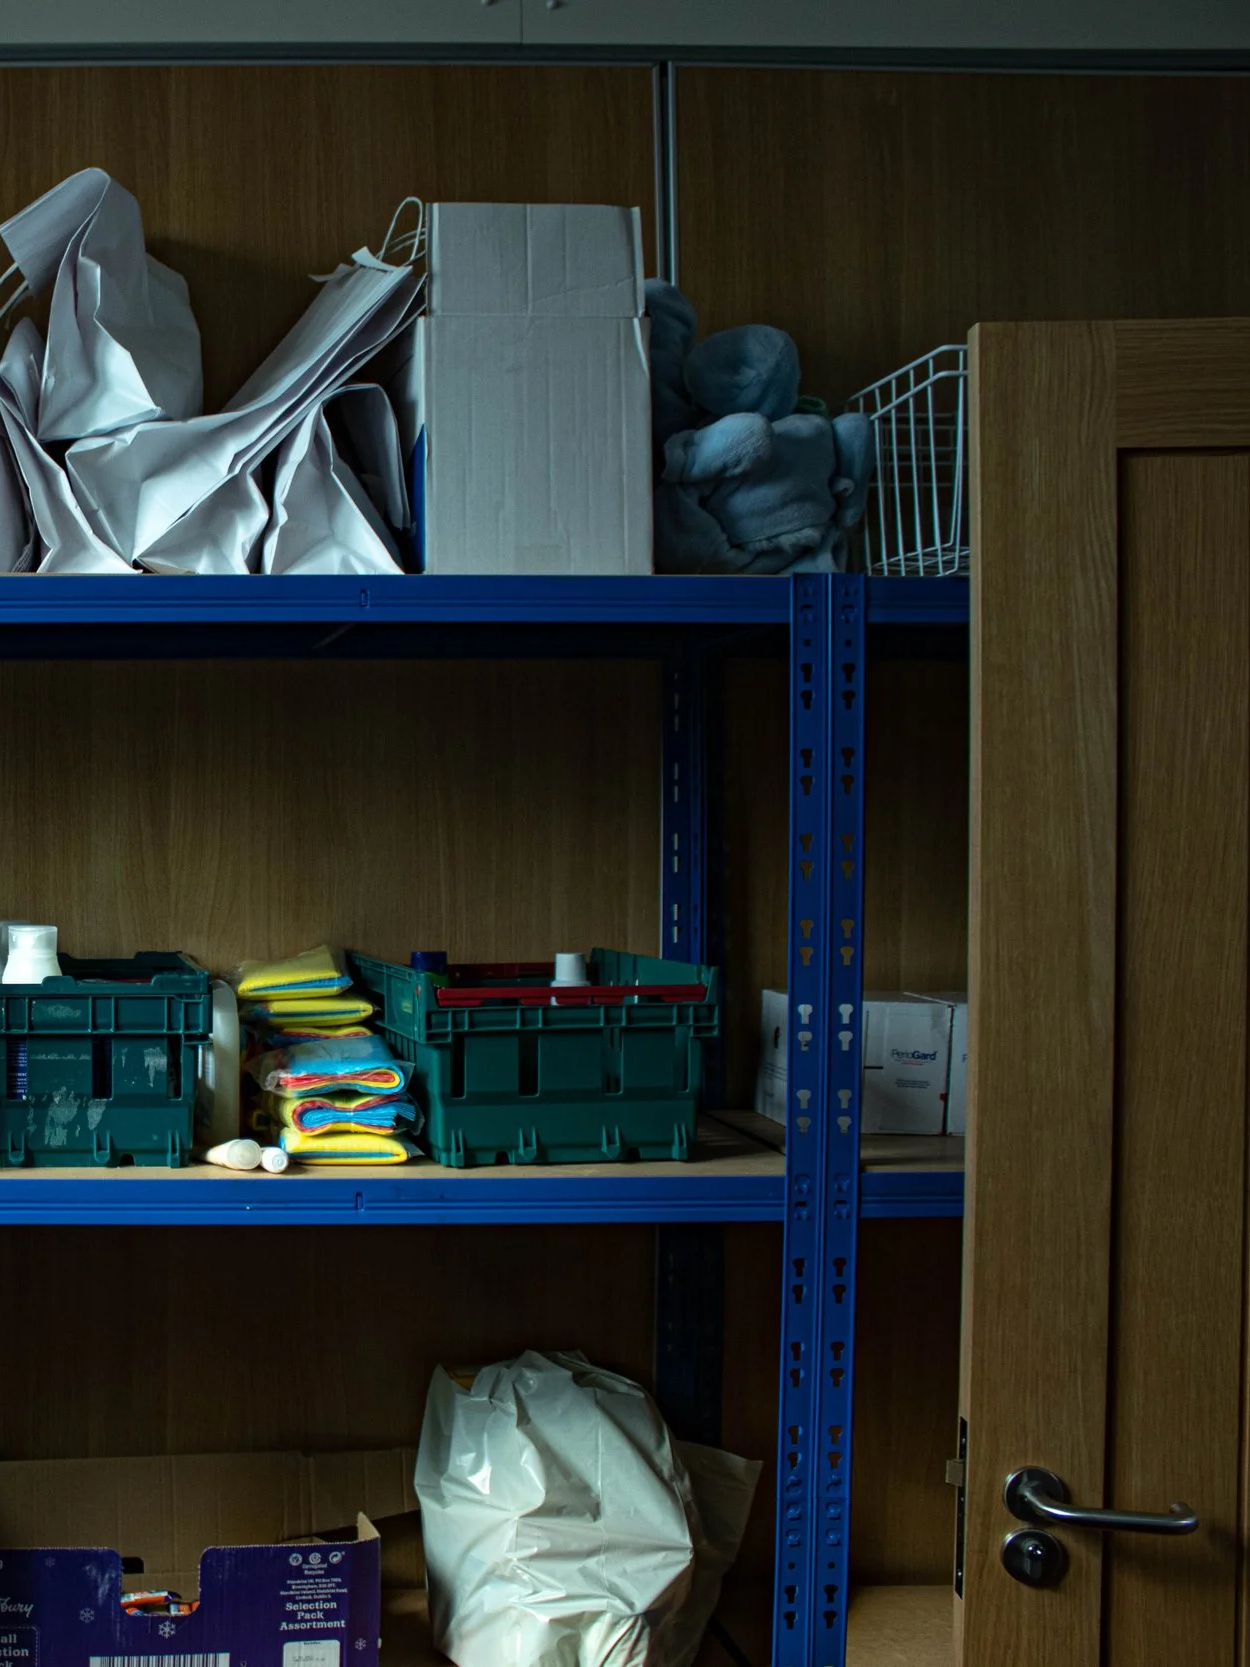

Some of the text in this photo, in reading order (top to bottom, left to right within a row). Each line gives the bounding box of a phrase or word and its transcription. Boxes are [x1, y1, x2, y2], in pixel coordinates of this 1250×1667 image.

[891, 1049, 938, 1061] PerioGard
[285, 1601, 337, 1611] Selection
[297, 1611, 324, 1620] Pack
[279, 1620, 346, 1631] Assortment
